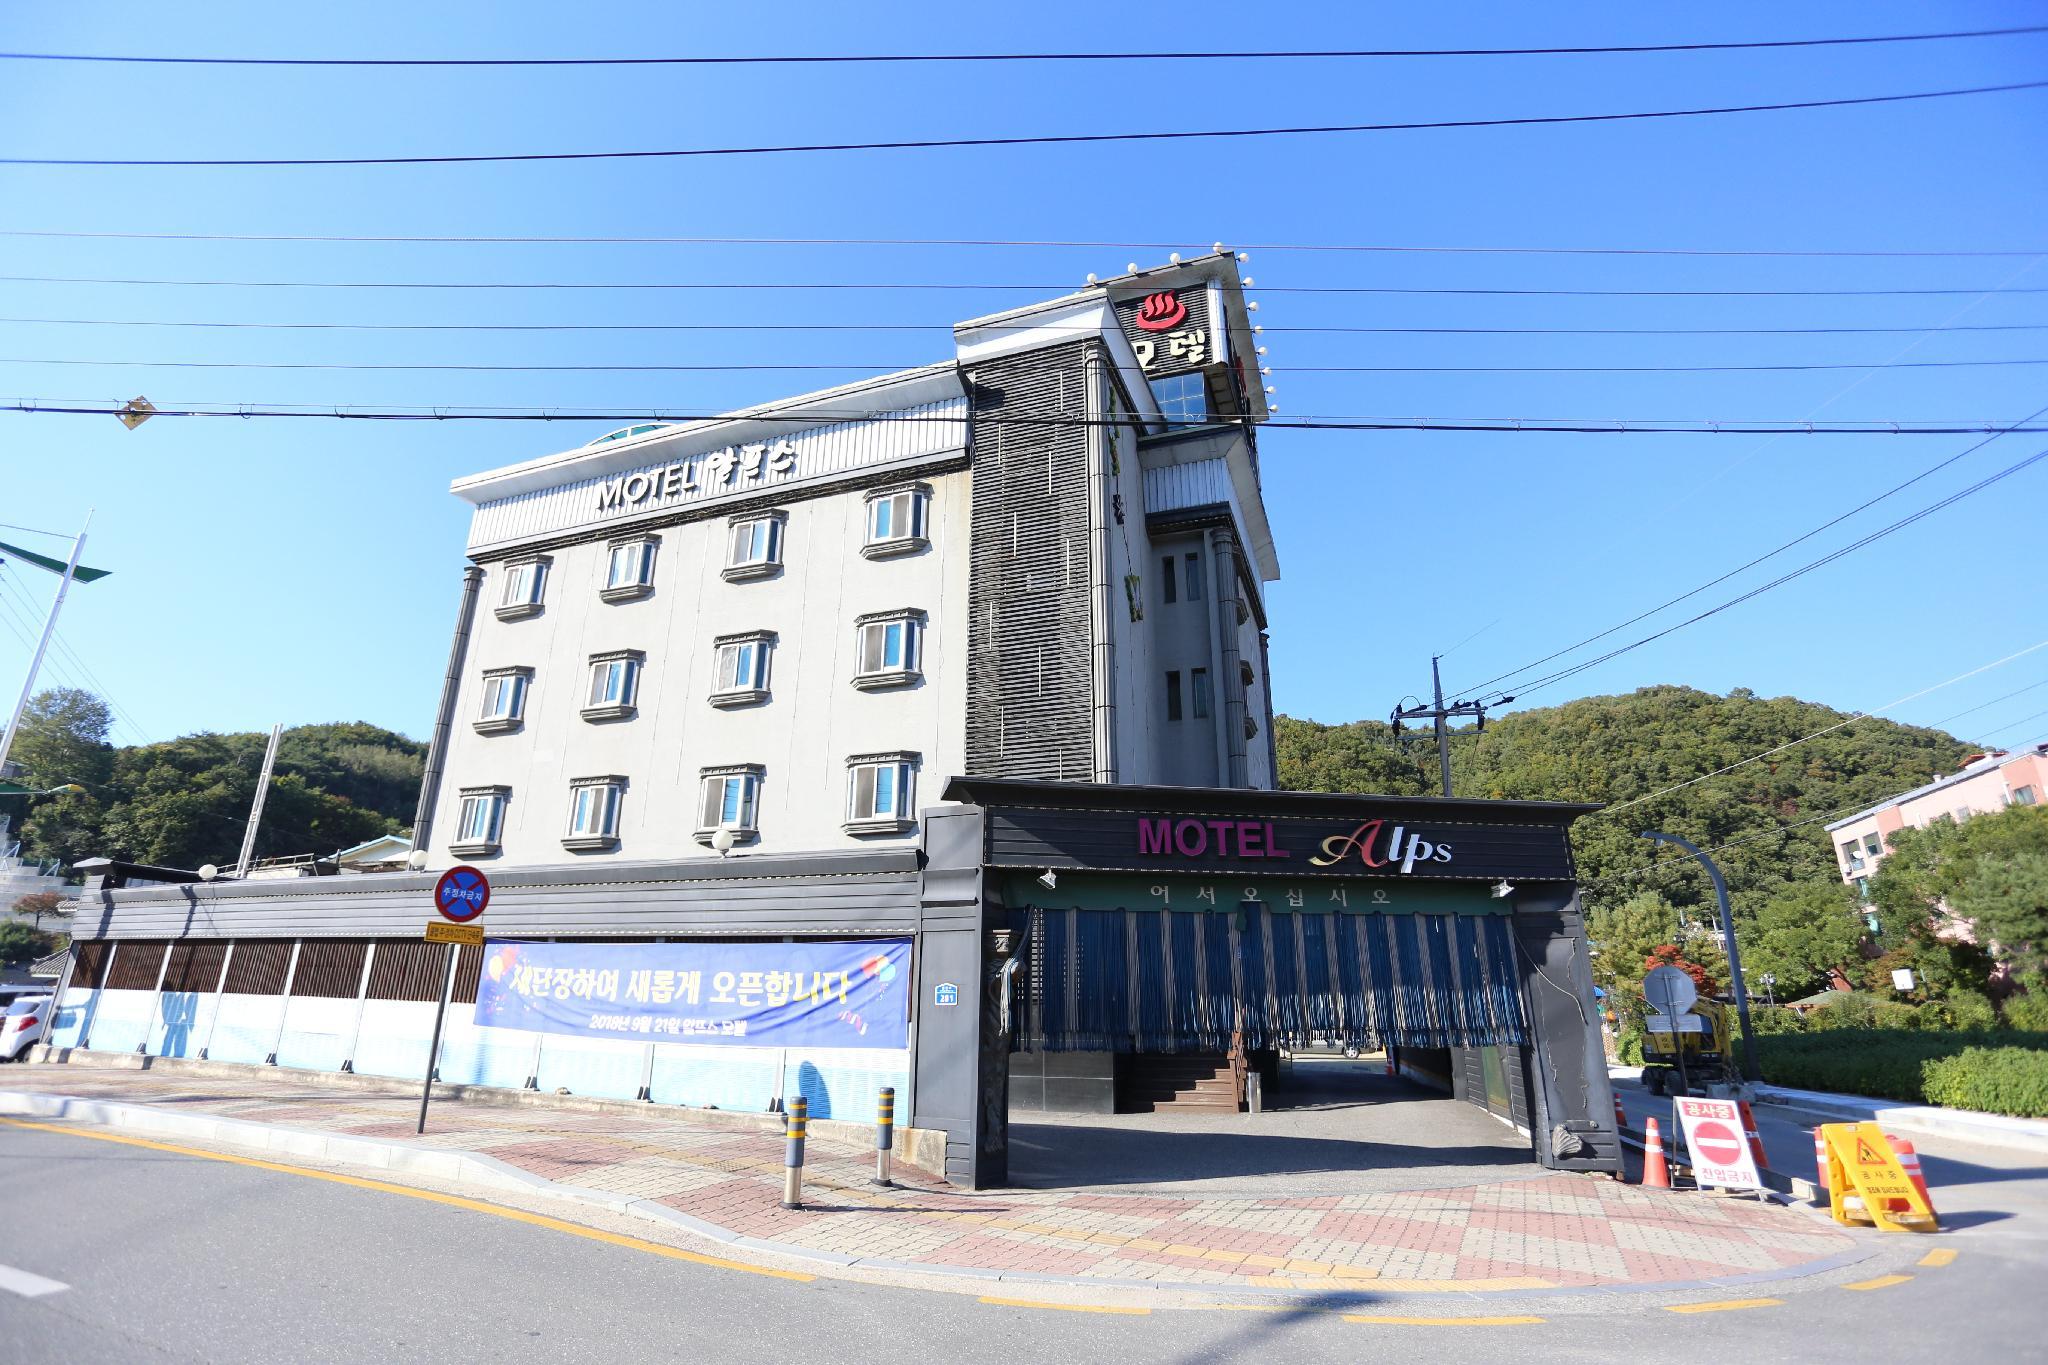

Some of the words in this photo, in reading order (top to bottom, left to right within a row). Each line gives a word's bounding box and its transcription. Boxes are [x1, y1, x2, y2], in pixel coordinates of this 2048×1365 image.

[596, 461, 698, 511] MOTEL
[1137, 818, 1290, 858] MOTEL
[1308, 819, 1453, 874] Alps
[443, 888, 482, 902] 주정차금지
[509, 964, 620, 1002] 새단장하여
[625, 969, 702, 1005] 새롭게
[709, 970, 852, 1006] 오픈합니다
[589, 1014, 631, 1032] 2018년
[630, 1015, 652, 1033] 9월
[653, 1016, 681, 1034] 21일
[1687, 1102, 1731, 1119] 공사중
[1702, 1167, 1754, 1185] 진입금지
